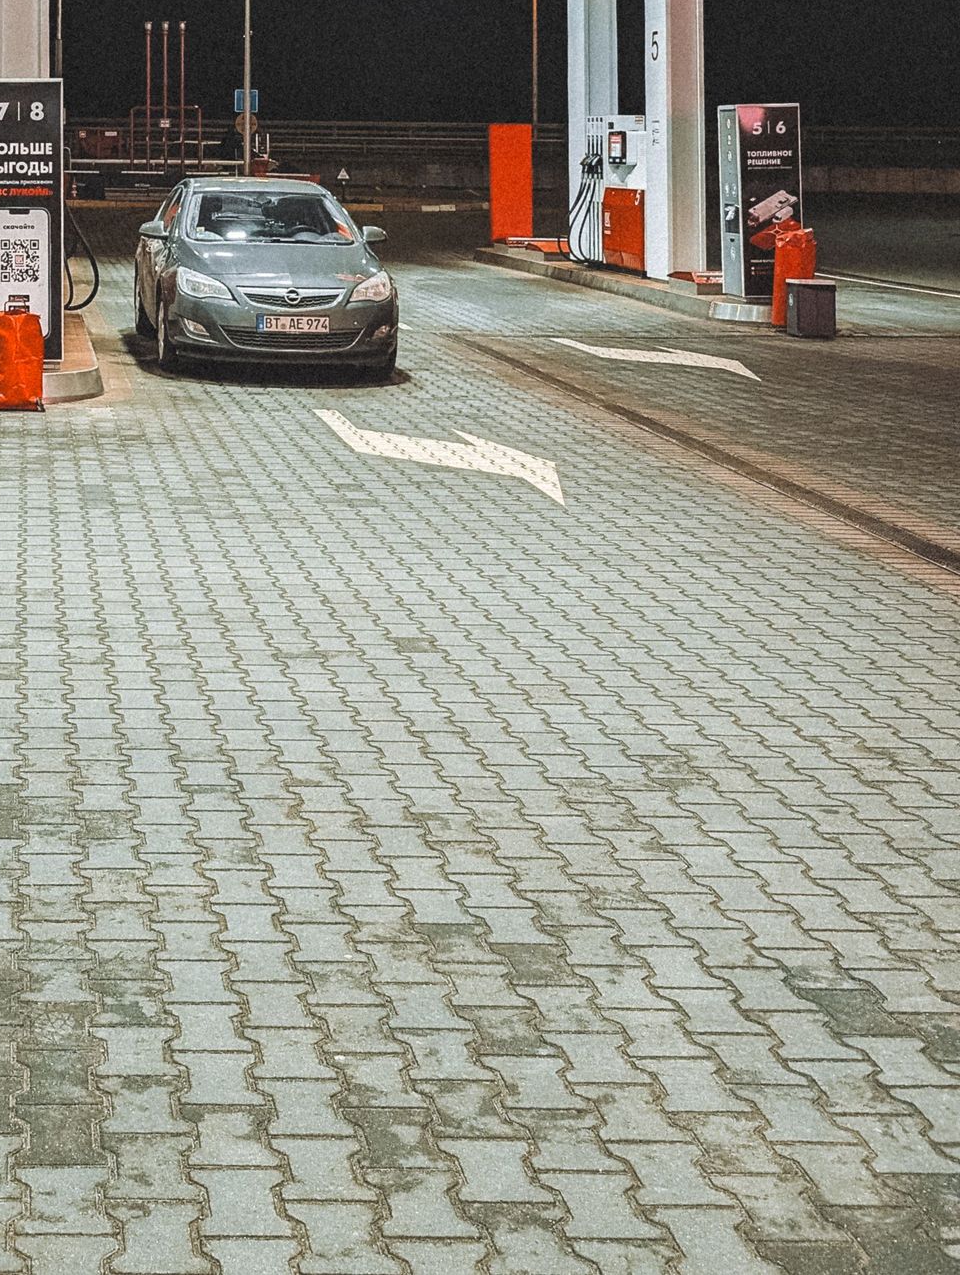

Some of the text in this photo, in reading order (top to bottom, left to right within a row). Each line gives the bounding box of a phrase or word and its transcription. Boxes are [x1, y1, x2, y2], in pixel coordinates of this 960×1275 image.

[651, 31, 659, 61] 5
[634, 189, 642, 205] 5
[265, 317, 328, 330] BT AE 974
